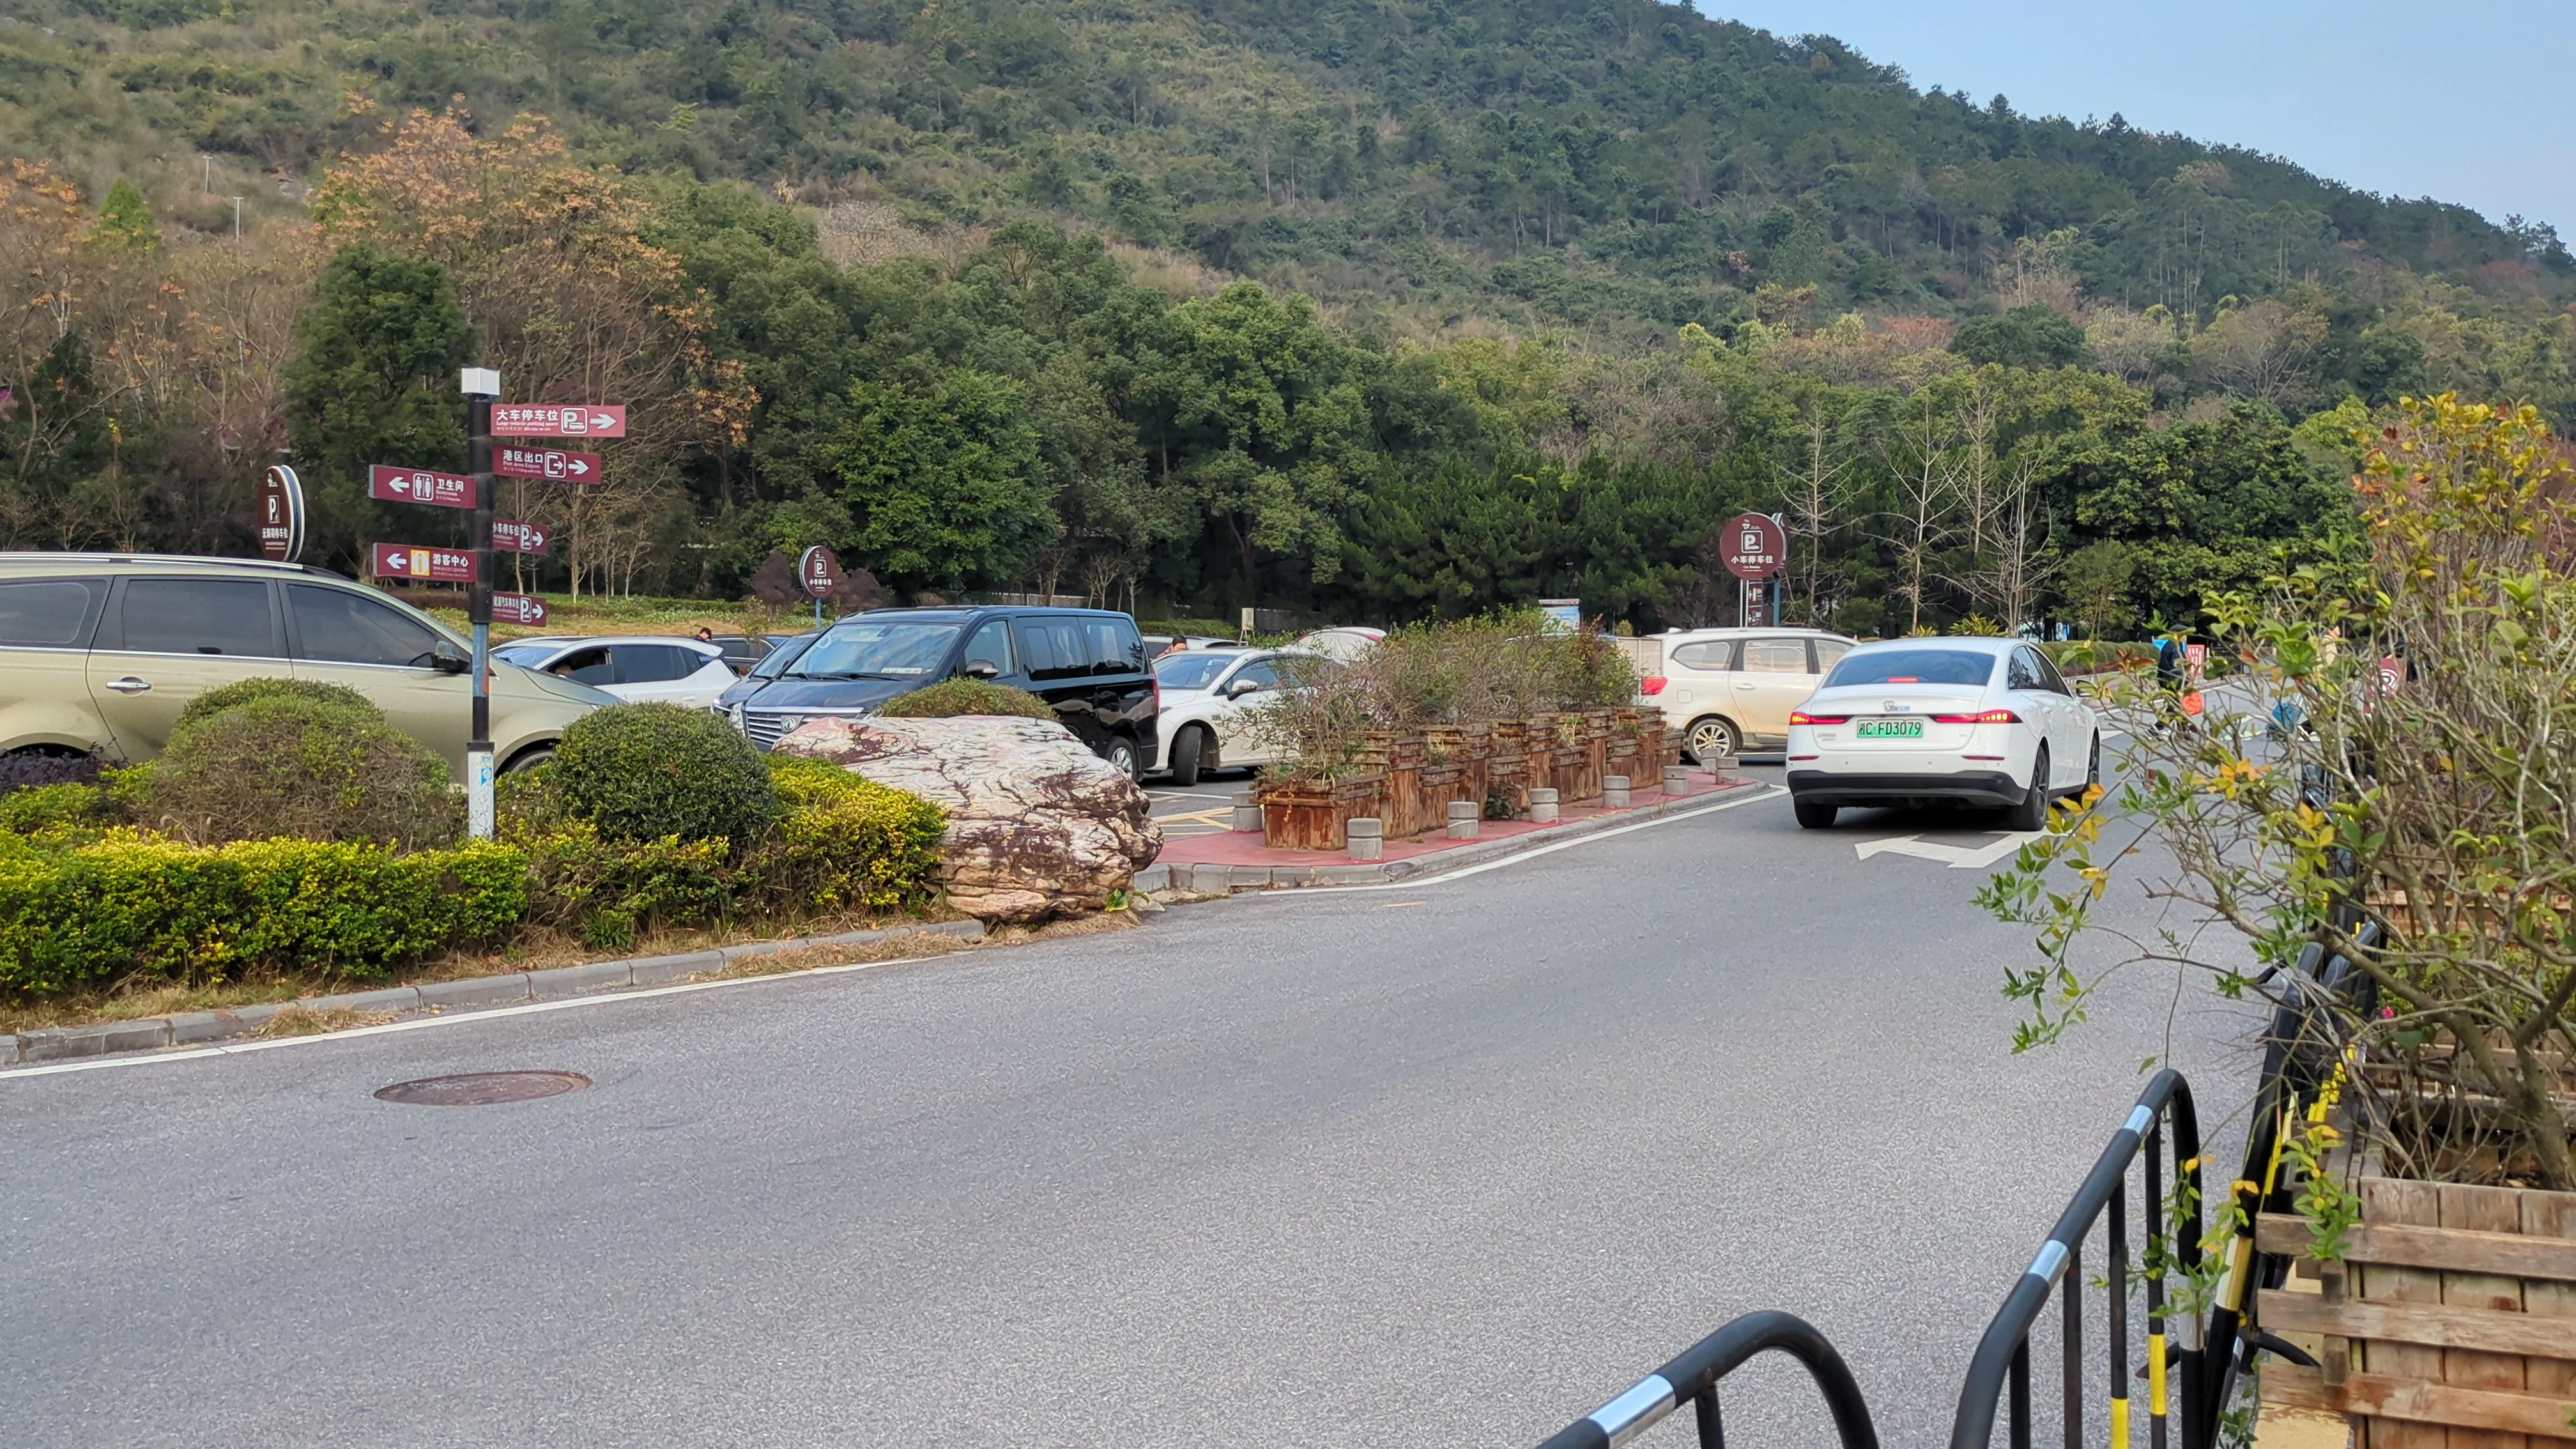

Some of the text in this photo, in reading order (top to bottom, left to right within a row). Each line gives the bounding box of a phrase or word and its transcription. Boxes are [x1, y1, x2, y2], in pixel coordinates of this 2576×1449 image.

[496, 409, 558, 421] 大车停车位
[503, 450, 543, 463] 港区出口
[436, 479, 464, 492] 卫生间
[433, 553, 469, 567] 游客中心
[1731, 555, 1774, 564] 小车停车位
